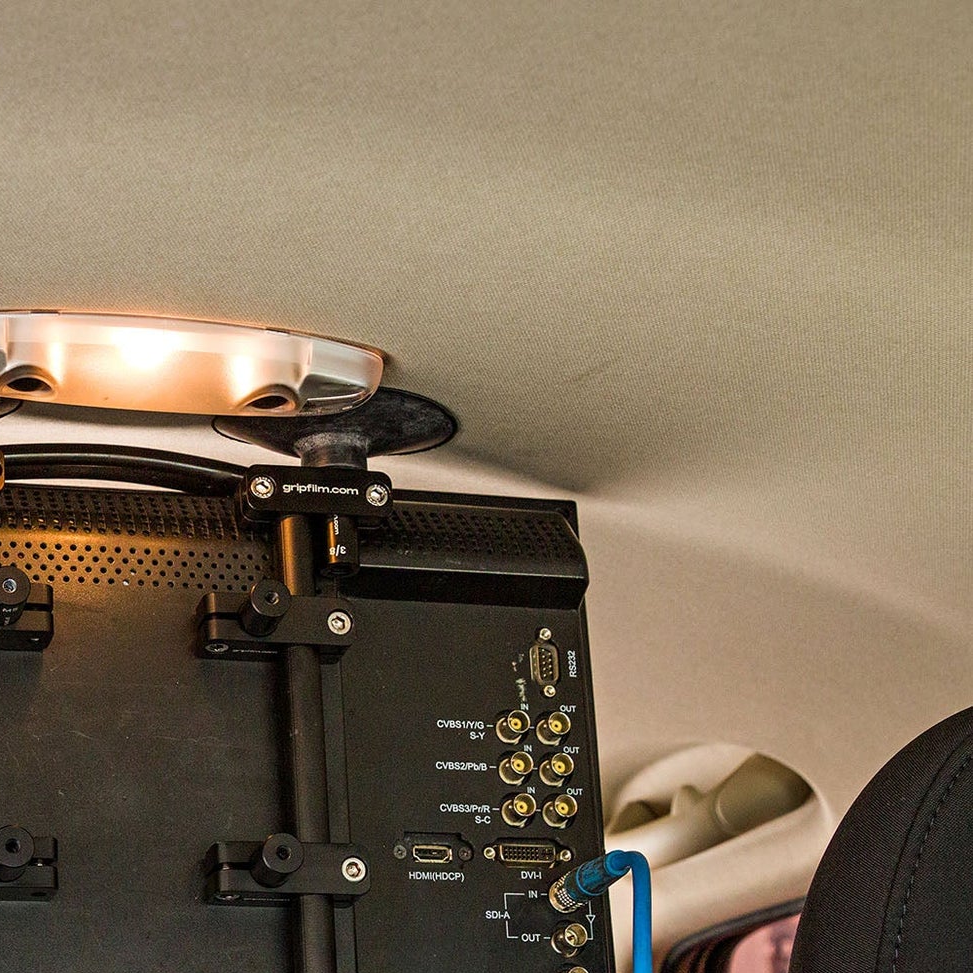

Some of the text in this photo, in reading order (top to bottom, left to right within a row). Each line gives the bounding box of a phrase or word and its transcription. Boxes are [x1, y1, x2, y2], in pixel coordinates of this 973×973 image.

[283, 483, 358, 495] gripfilm.com
[568, 650, 577, 677] RS232
[437, 720, 484, 729] CVBS1/Y/G
[563, 746, 580, 754] OUT
[435, 761, 488, 771] CVBS2/Pb/B
[567, 788, 583, 796] OUT
[439, 804, 490, 813] CVBS3/Pr/R
[475, 816, 491, 824] S-C
[409, 871, 464, 882] HDMI(HDCP)
[521, 871, 542, 879] DVI-I
[528, 890, 538, 898] IN
[486, 910, 510, 919] SDI-A
[521, 934, 540, 942] OUT
